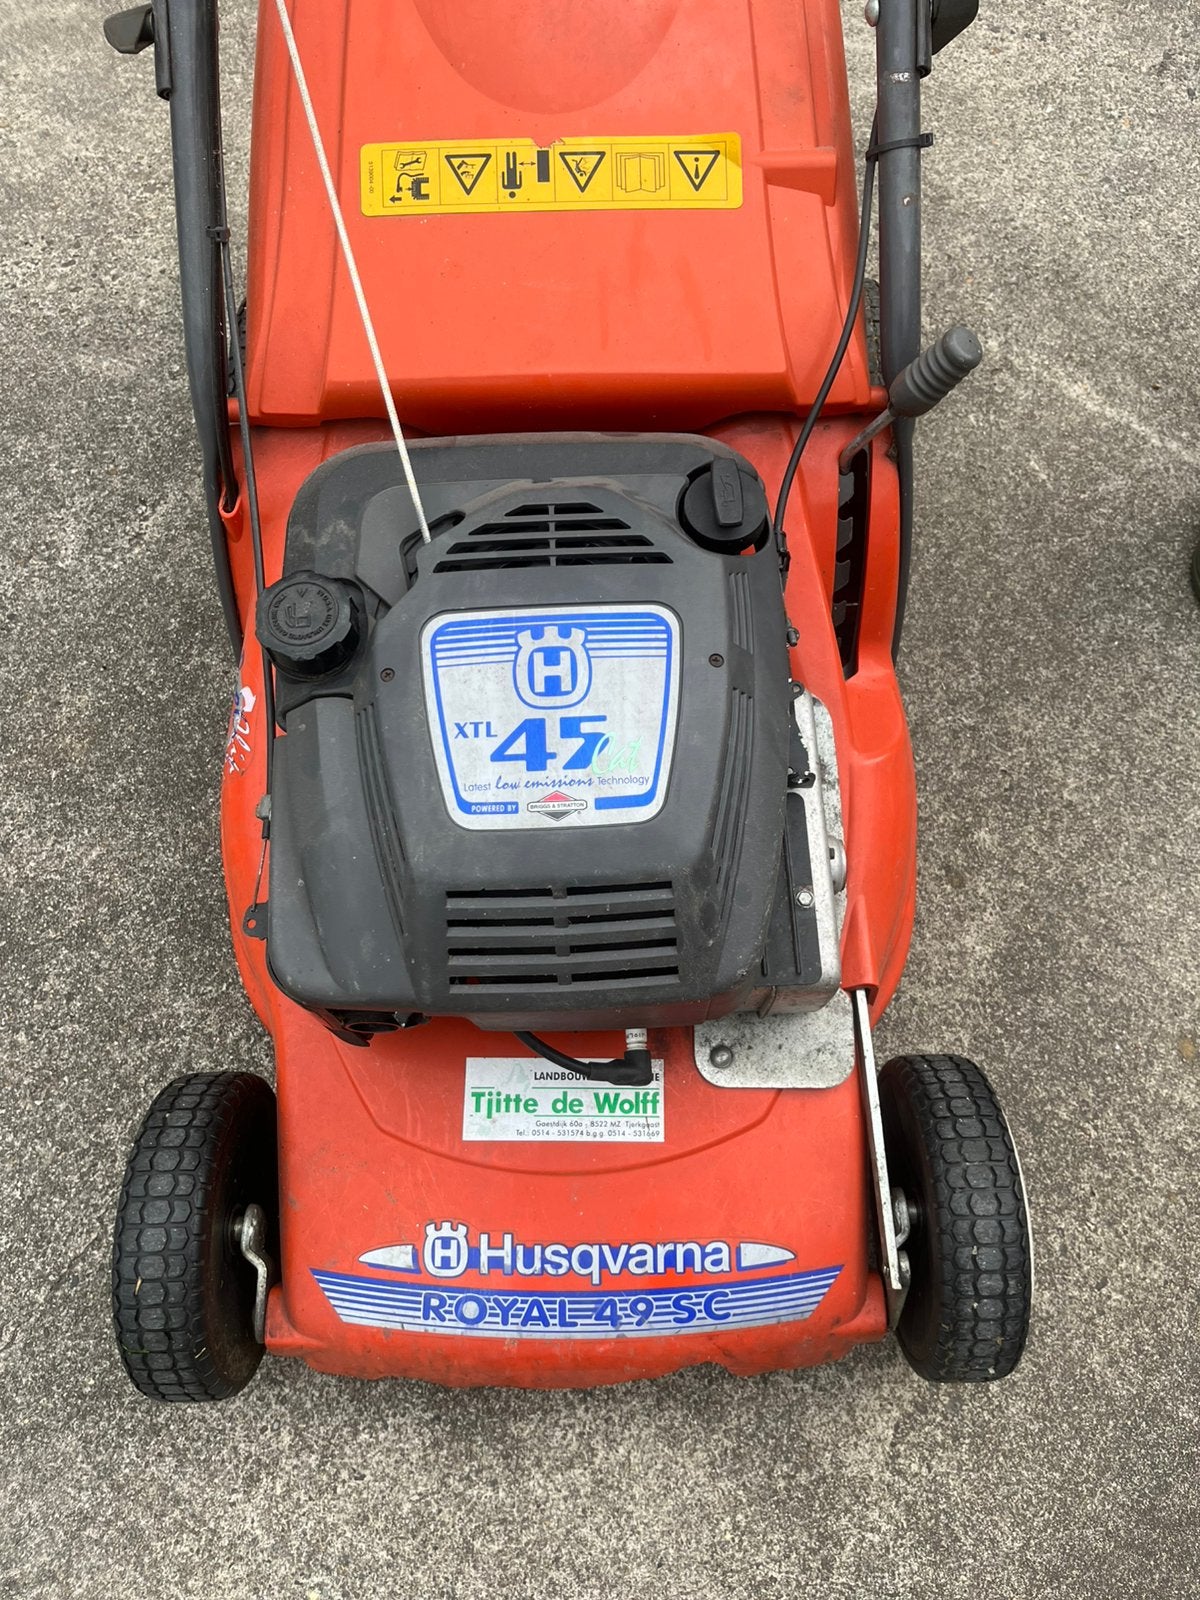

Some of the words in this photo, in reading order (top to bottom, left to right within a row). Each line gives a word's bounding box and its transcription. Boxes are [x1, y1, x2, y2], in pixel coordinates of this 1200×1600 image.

[454, 721, 498, 739] XTL
[490, 714, 610, 772] 45
[463, 782, 491, 792] Latest
[495, 775, 520, 790] low
[524, 775, 594, 789] emissions
[597, 776, 650, 787] Technology
[471, 804, 504, 813] POWERED
[507, 804, 517, 812] BY
[471, 1091, 539, 1119] Tjitte
[551, 1091, 584, 1114] de
[593, 1091, 660, 1114] Wolff
[531, 1129, 550, 1137] 0514
[590, 1120, 608, 1128] 8522
[610, 1120, 621, 1128] MZ
[479, 1232, 732, 1285] Husqvarna
[421, 1291, 580, 1328] ROYAL
[592, 1296, 655, 1328] 49
